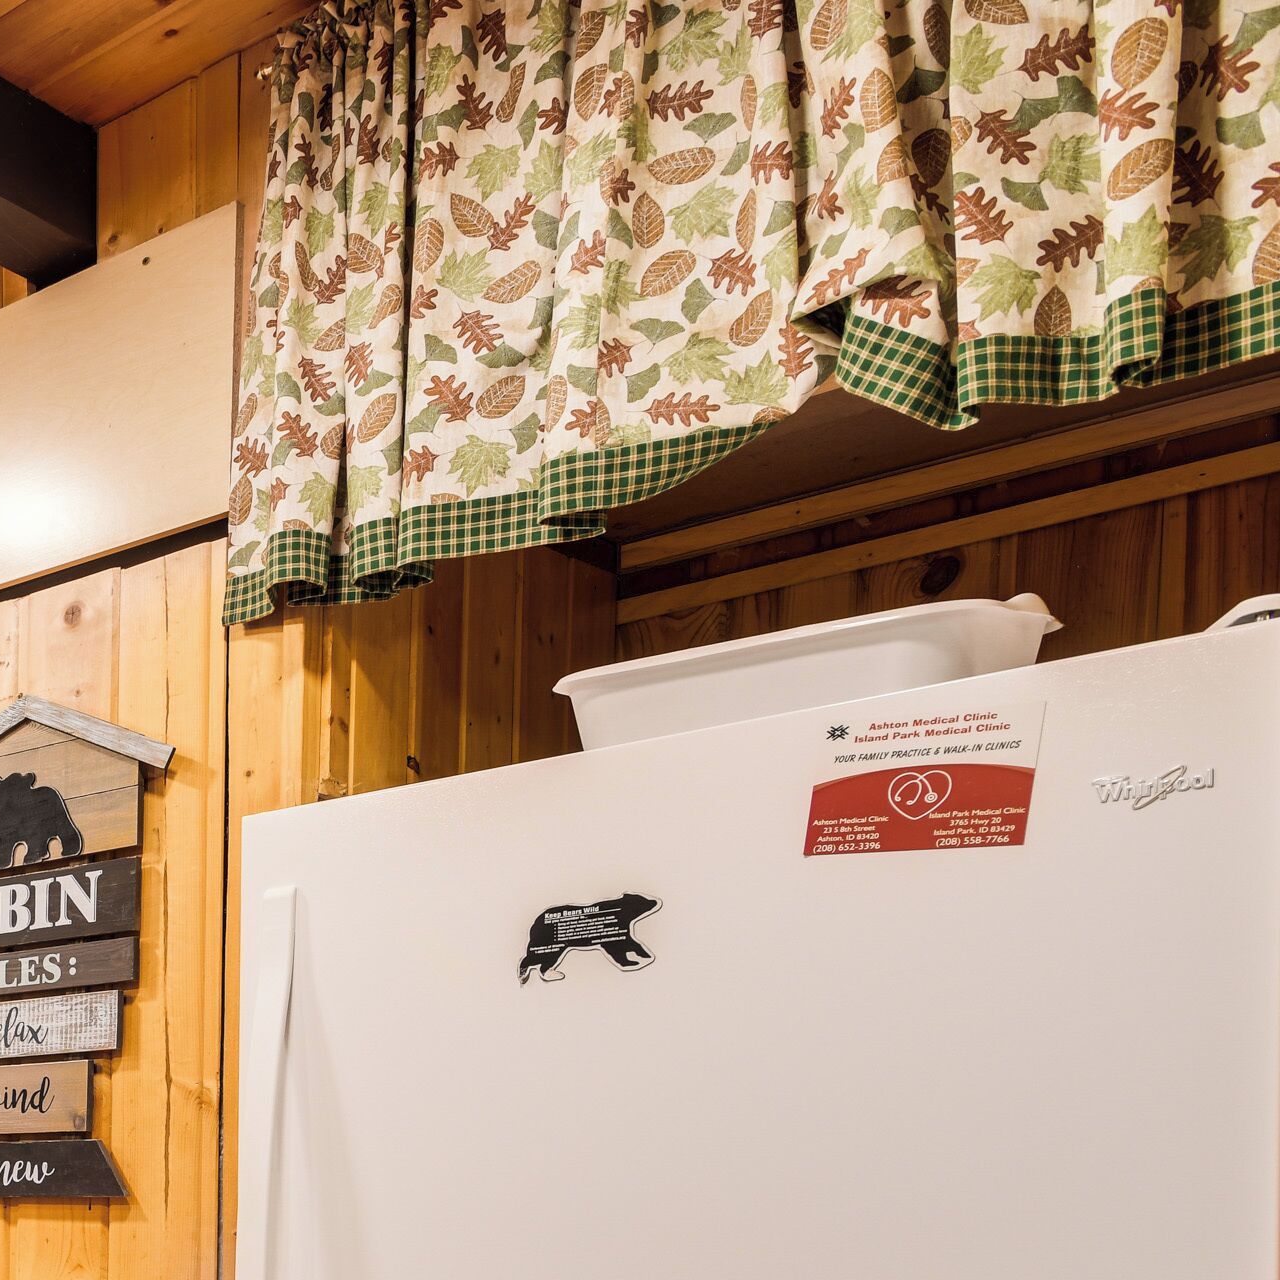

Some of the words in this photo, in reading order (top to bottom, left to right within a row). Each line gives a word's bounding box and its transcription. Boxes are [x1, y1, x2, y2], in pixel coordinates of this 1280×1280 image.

[869, 720, 908, 731] Ashton
[912, 715, 959, 727] Medical
[963, 711, 998, 722] Clinic
[854, 731, 889, 743] Island
[892, 731, 920, 740] Park
[924, 725, 972, 737] Medical
[976, 722, 1011, 732] Clinic
[834, 754, 857, 763] YOUR
[858, 751, 889, 762] FAMILY
[891, 748, 931, 759] PRACTICE
[934, 748, 940, 756] &
[943, 743, 982, 755] WALK-IN
[985, 740, 1022, 751] CLINICS
[1094, 767, 1215, 804] Whirlpool
[813, 844, 836, 854] (208)
[839, 842, 880, 851] 652-3396
[936, 839, 961, 847] (208)
[964, 835, 1009, 844] 558-7766
[563, 909, 582, 917] Bears
